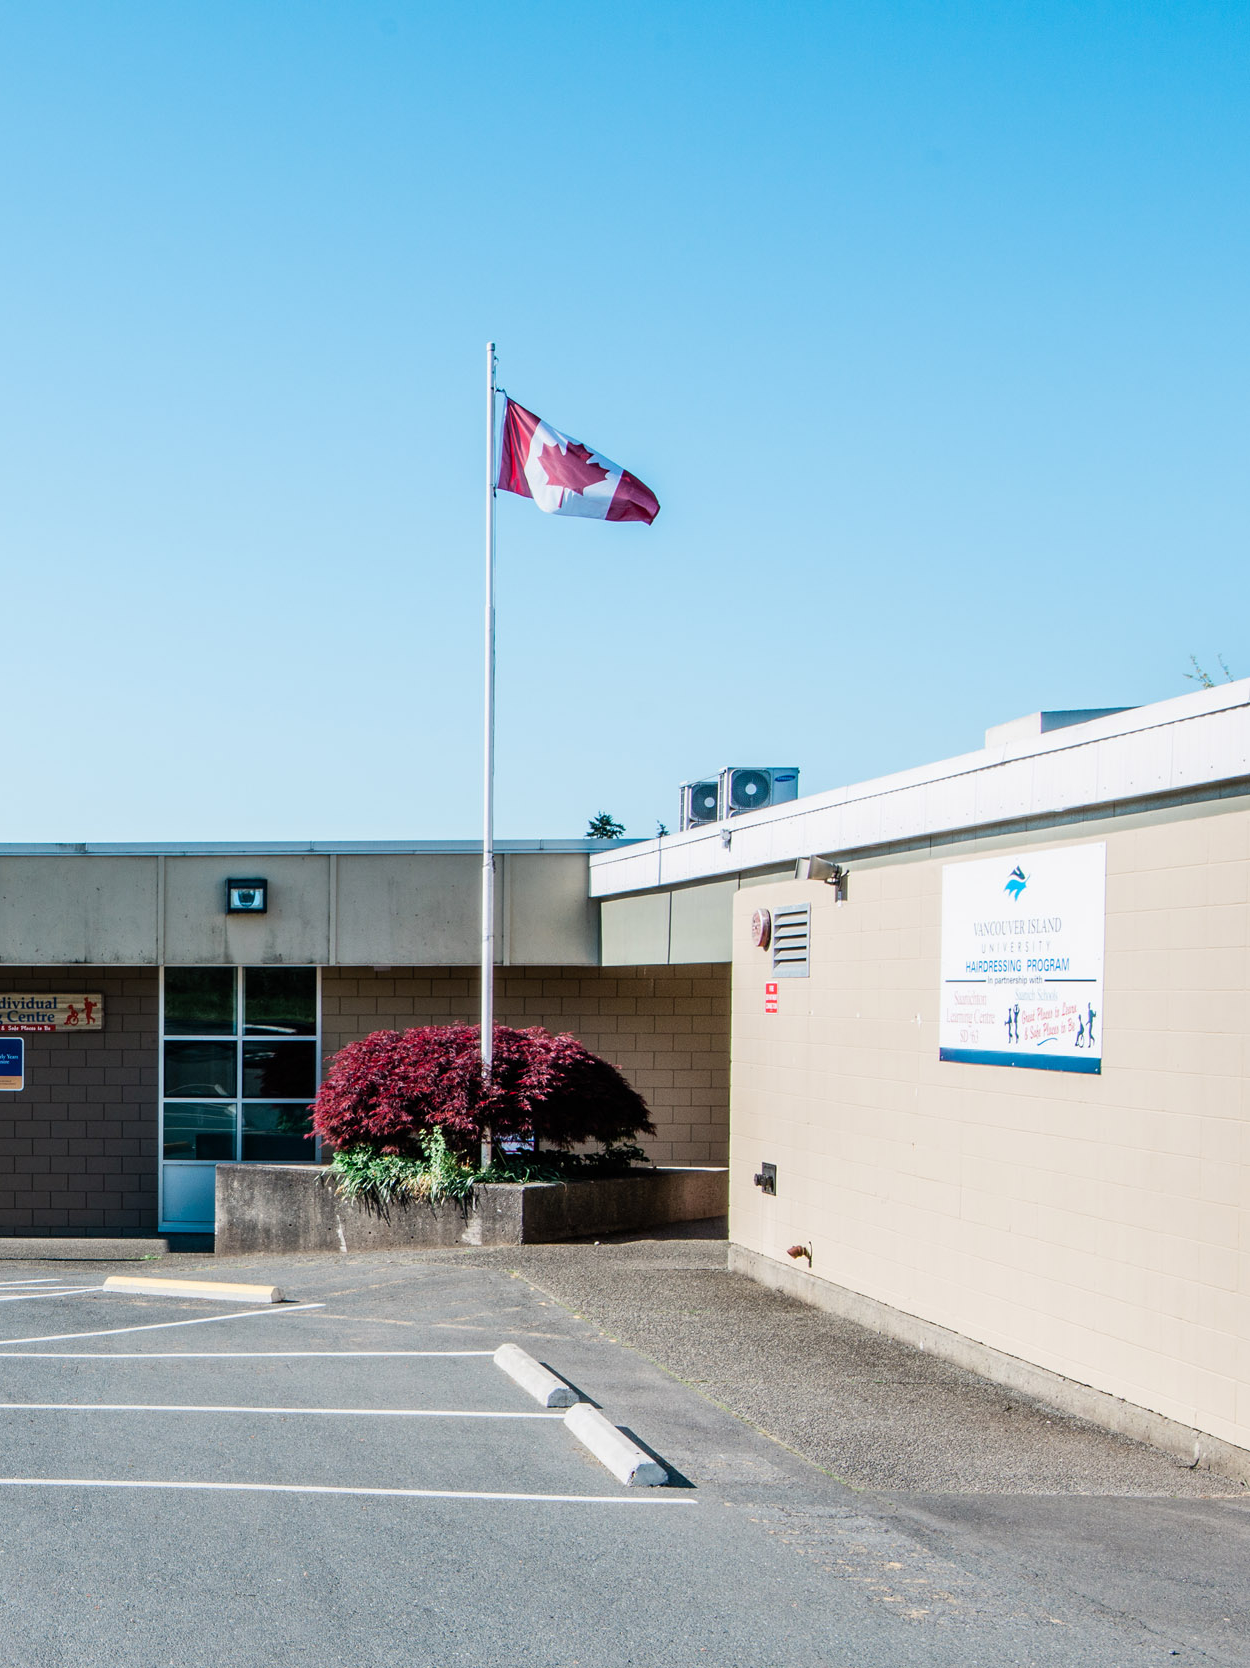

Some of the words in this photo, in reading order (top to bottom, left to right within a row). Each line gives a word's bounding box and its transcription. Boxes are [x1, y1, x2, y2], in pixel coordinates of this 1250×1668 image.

[973, 919, 1025, 937] VANCOUVER
[1027, 917, 1062, 935] ISLAND
[981, 940, 1052, 954] UNIVERSITY
[965, 959, 1022, 973] HAIRDRESSING
[1027, 957, 1070, 972] PROGRAM
[994, 976, 1028, 985] partnership
[1029, 975, 1043, 984] with
[1037, 989, 1058, 1002] Schools
[7, 1010, 55, 1023] Centre
[946, 1007, 973, 1028] Learning
[973, 1008, 995, 1024] Centre
[1021, 1009, 1035, 1024] Great
[1037, 1007, 1053, 1021] Places
[1043, 1022, 1059, 1036] Places
[1067, 1017, 1075, 1032] Be
